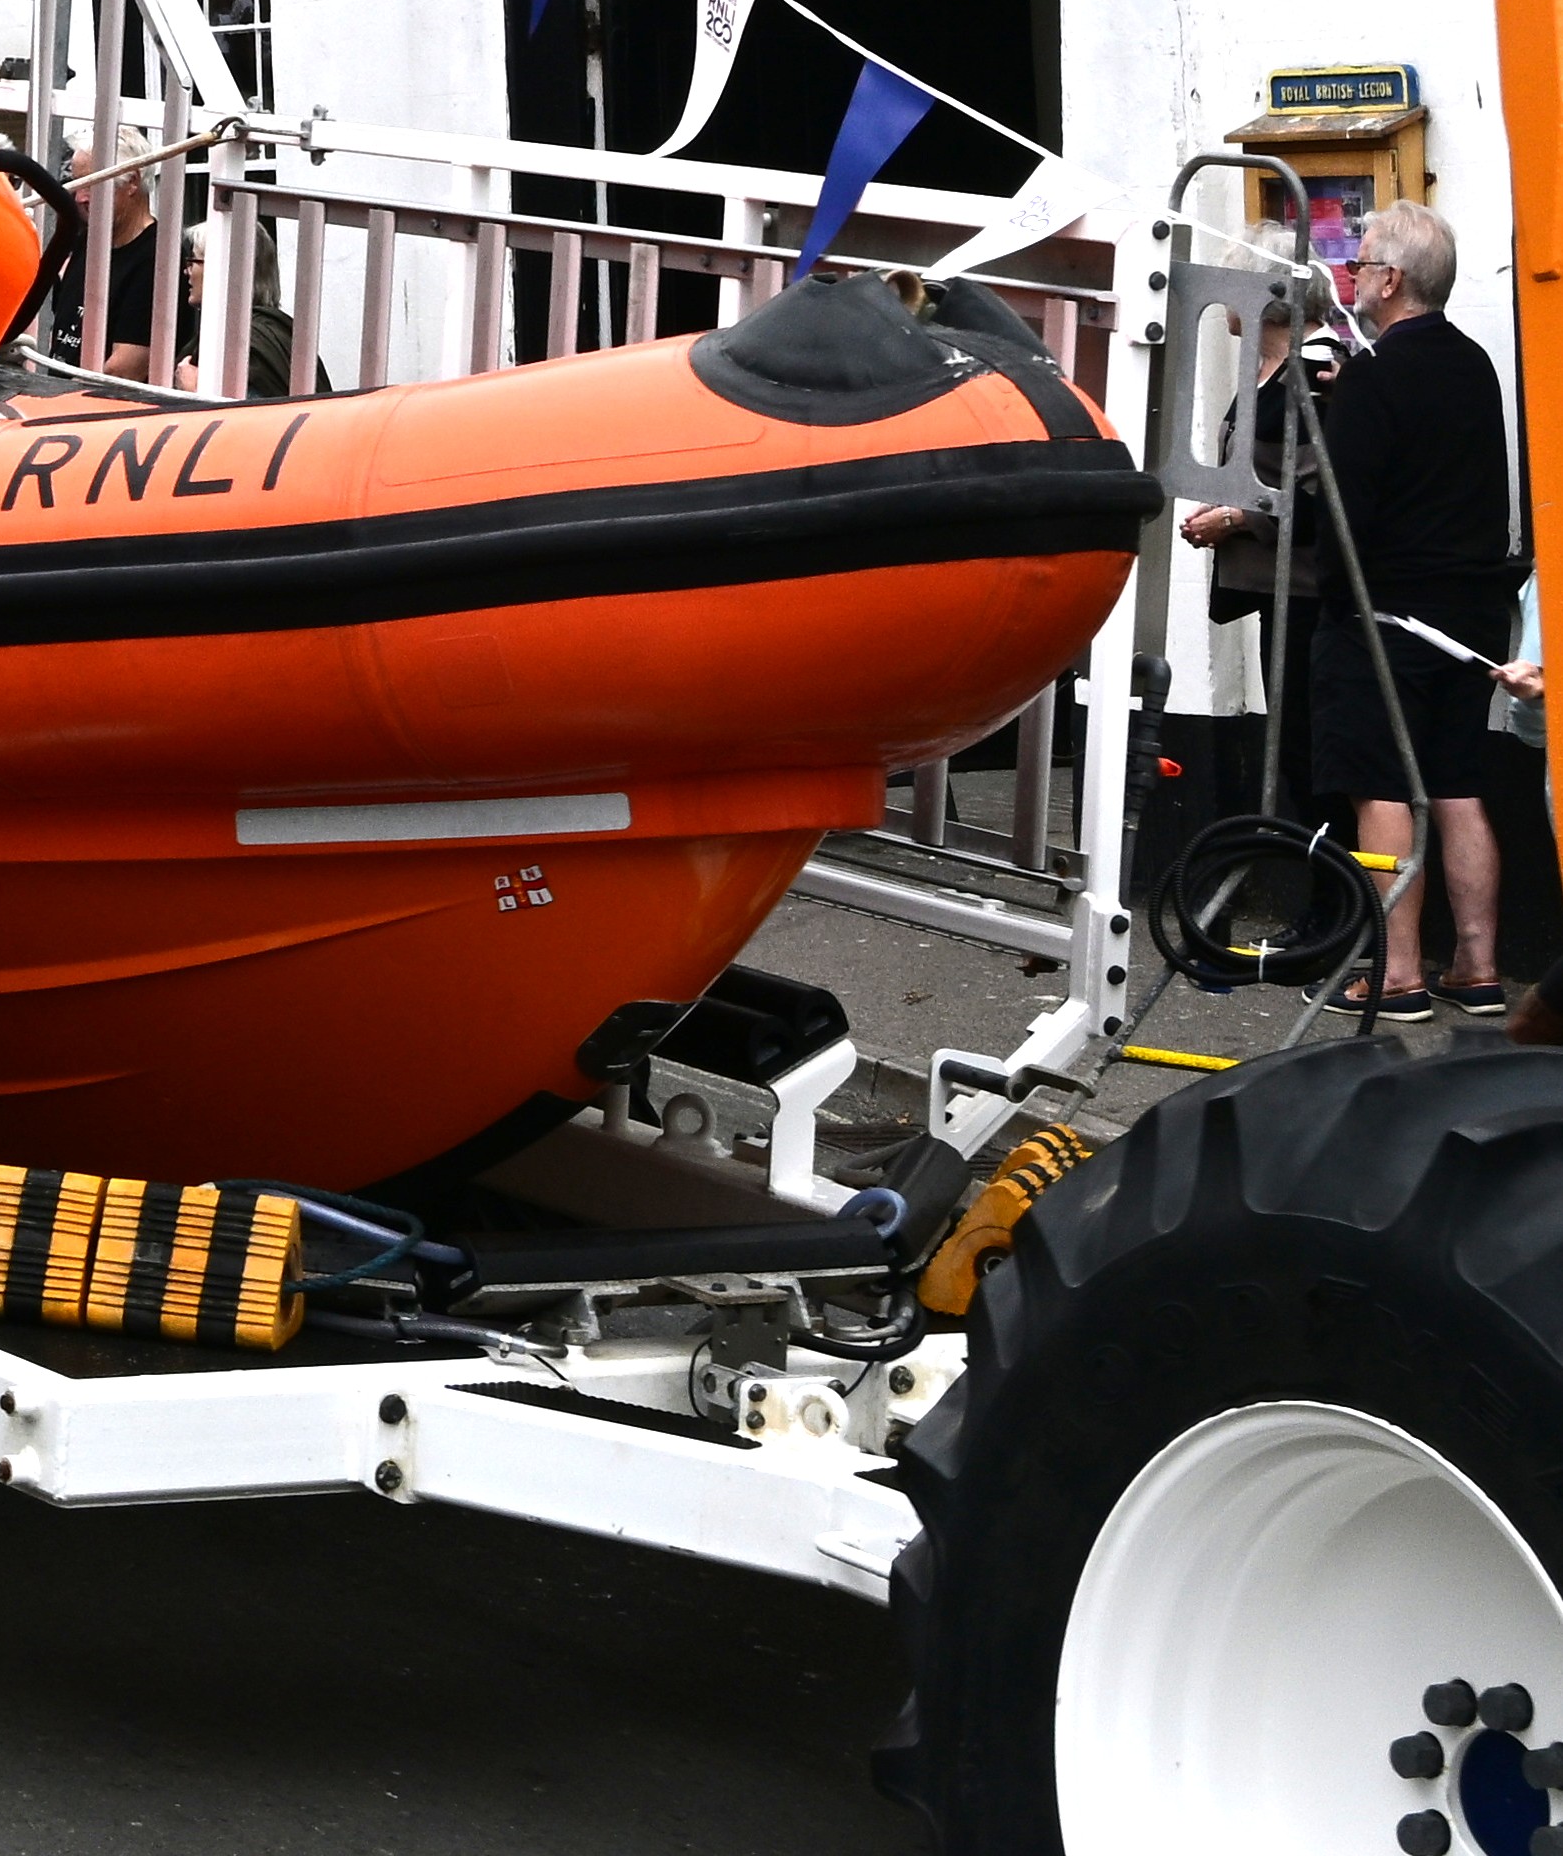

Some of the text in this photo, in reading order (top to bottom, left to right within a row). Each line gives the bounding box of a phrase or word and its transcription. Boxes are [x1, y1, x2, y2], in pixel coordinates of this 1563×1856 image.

[1281, 81, 1393, 102] ROYAL BRITISH LEGION
[0, 413, 310, 512] RNLI
